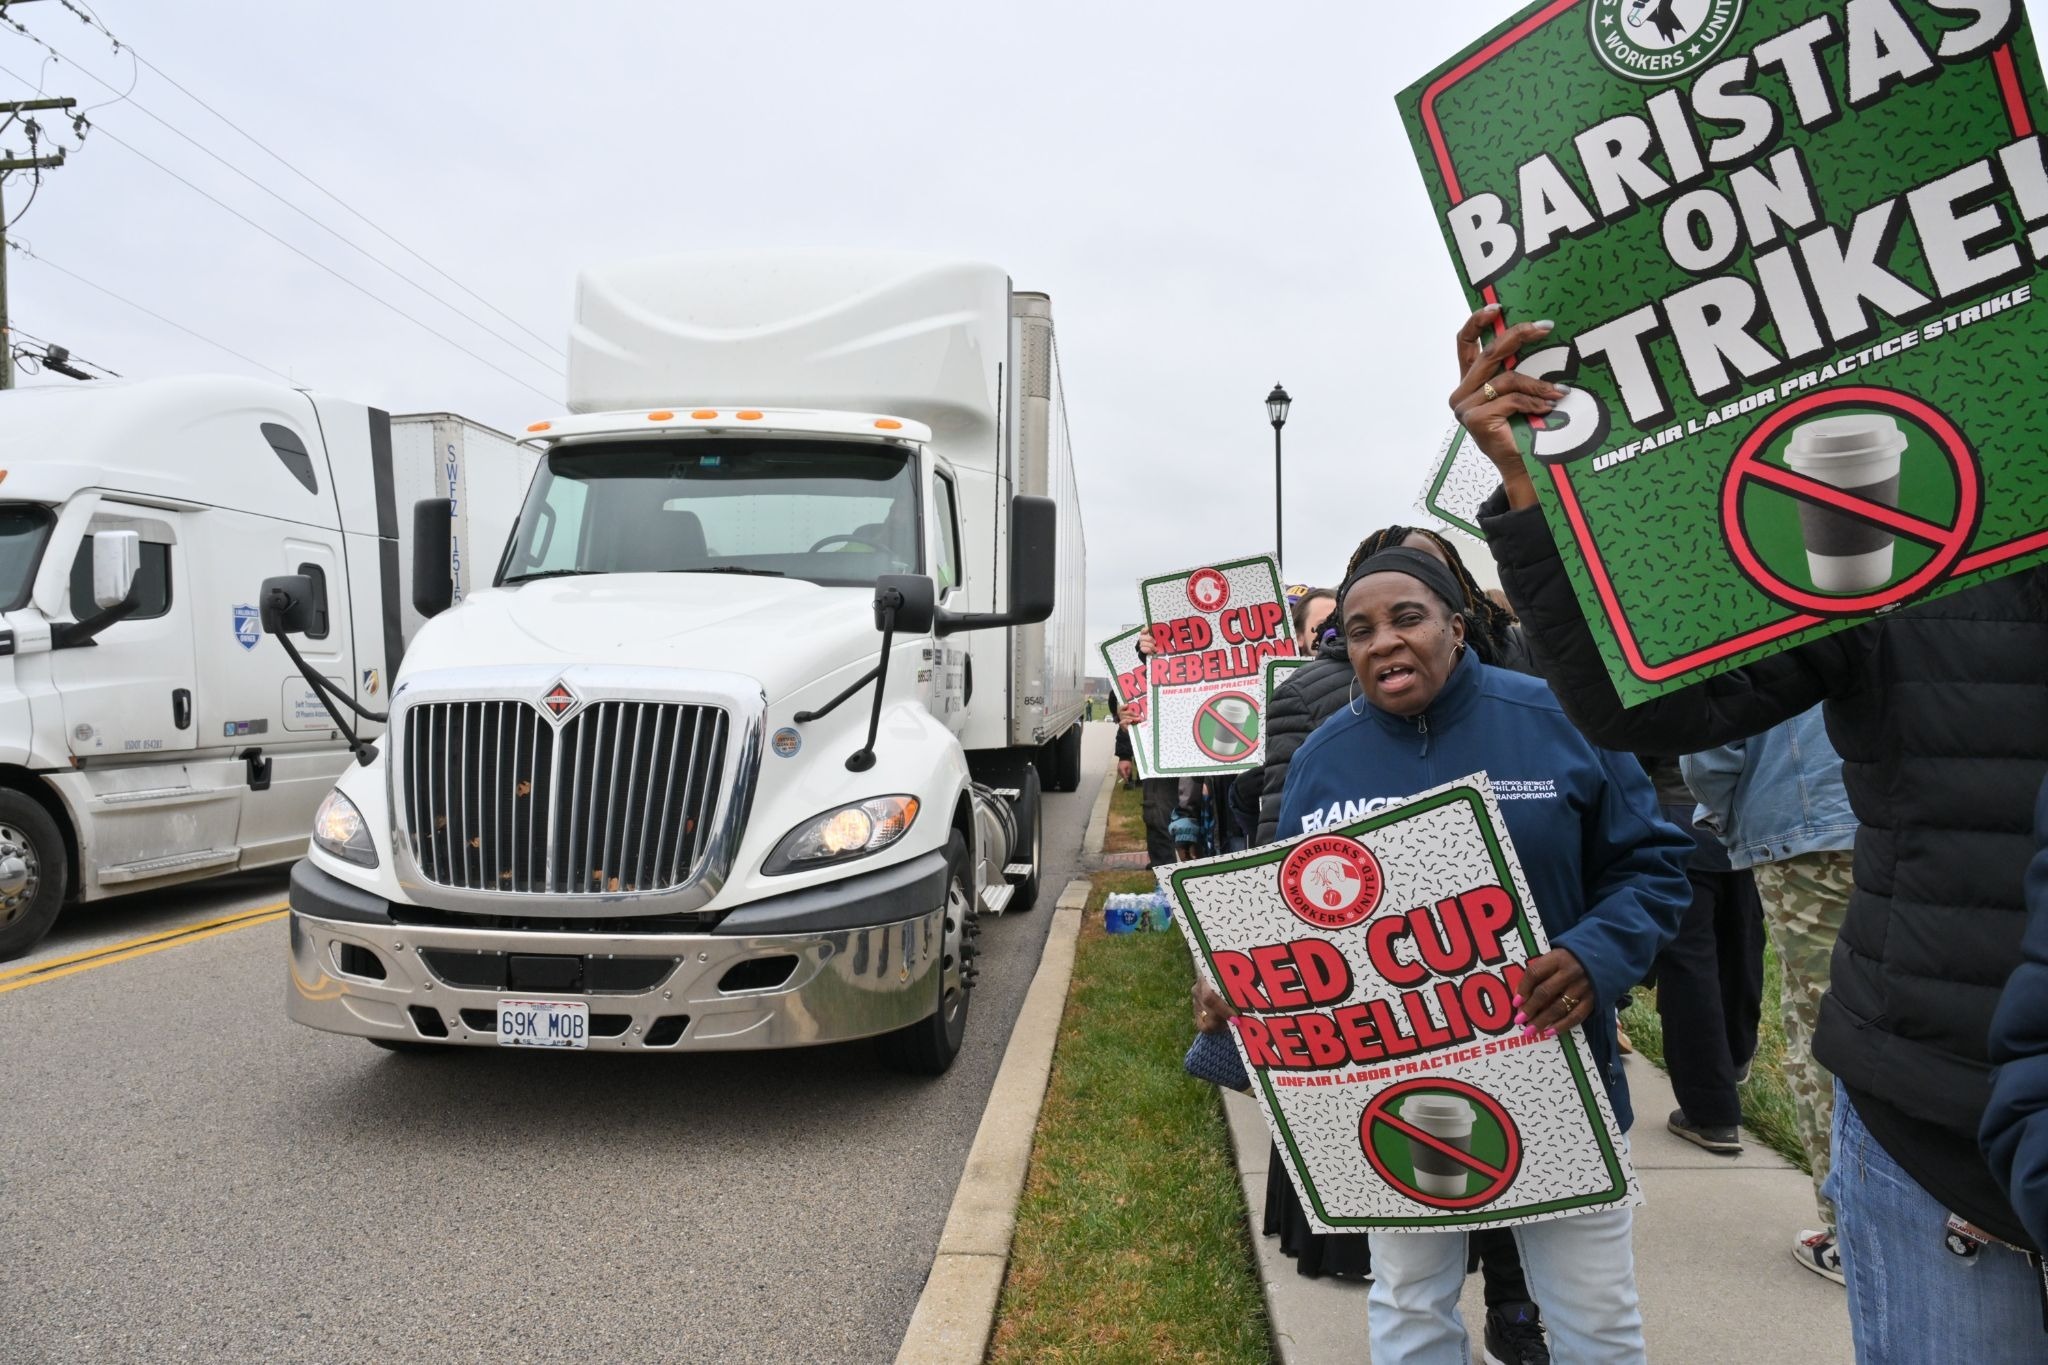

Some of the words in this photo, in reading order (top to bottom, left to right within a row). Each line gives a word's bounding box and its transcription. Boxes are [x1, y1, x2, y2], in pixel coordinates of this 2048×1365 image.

[1604, 30, 1685, 70] WORKERS
[1447, 0, 2014, 286] BARISTAS
[1662, 147, 1818, 272] ON
[1514, 135, 2048, 456] STRIKE!
[1592, 424, 1684, 472] UNFAIR
[1687, 387, 1776, 435] LABOR
[1780, 330, 1920, 398] PRACTICE
[1923, 285, 2032, 341] STRIKE
[446, 444, 458, 517] SWFZ
[1152, 616, 1213, 656] RED
[1219, 602, 1283, 645] CUP
[1151, 638, 1296, 687] REBELLION
[1162, 687, 1191, 695] UNFAIR
[1193, 685, 1219, 693] LABOR
[1221, 678, 1260, 689] PRACTICE
[1495, 792, 1557, 800] RANSPORTATION
[1288, 842, 1360, 877] STARBUCKS
[1288, 885, 1346, 923] WORKERS
[1353, 865, 1376, 915] UNITED
[1211, 938, 1354, 1013] RED
[1366, 884, 1519, 989] CUP
[502, 1011, 537, 1037] 69K
[1276, 1076, 1332, 1087] UNFAIR
[1335, 1067, 1392, 1085] LABOR
[1394, 1046, 1482, 1077] PRACTICE
[1484, 1030, 1551, 1056] STRIKE
